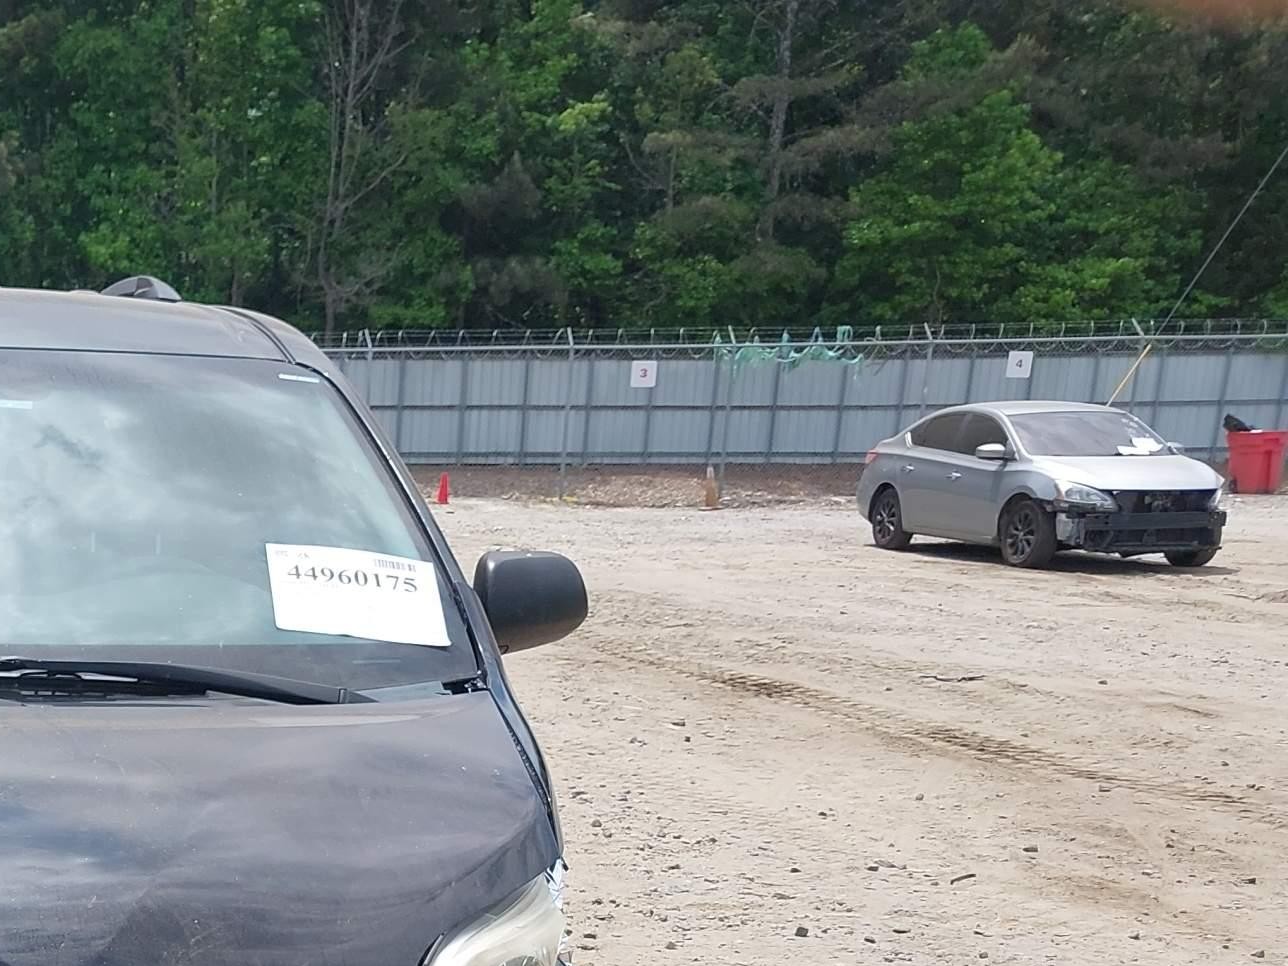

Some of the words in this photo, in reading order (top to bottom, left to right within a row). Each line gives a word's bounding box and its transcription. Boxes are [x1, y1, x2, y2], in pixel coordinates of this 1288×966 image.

[1015, 359, 1023, 369] 4
[639, 368, 648, 378] 3
[287, 564, 418, 593] 44960175
